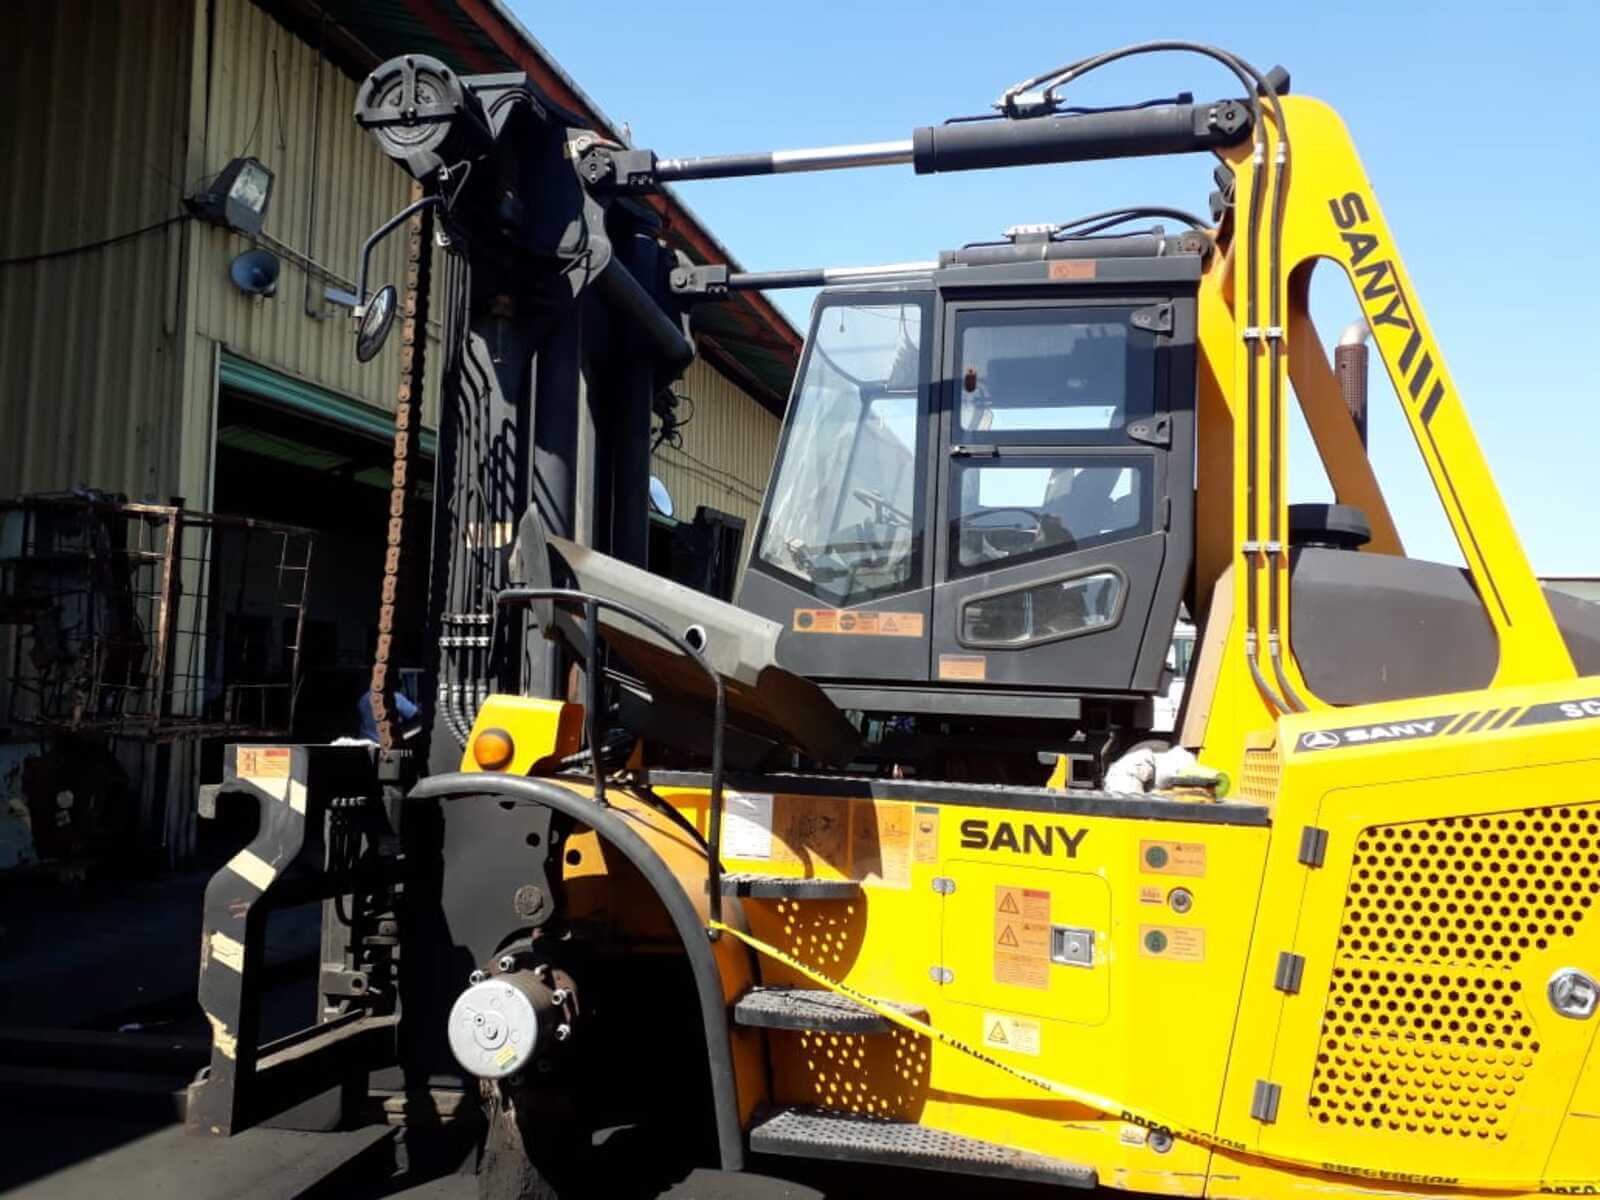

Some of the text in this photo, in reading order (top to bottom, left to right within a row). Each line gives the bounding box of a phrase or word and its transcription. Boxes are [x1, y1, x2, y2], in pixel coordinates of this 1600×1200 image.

[1328, 192, 1412, 330] SANY
[1344, 721, 1436, 742] SANY
[960, 819, 1089, 859] SANY
